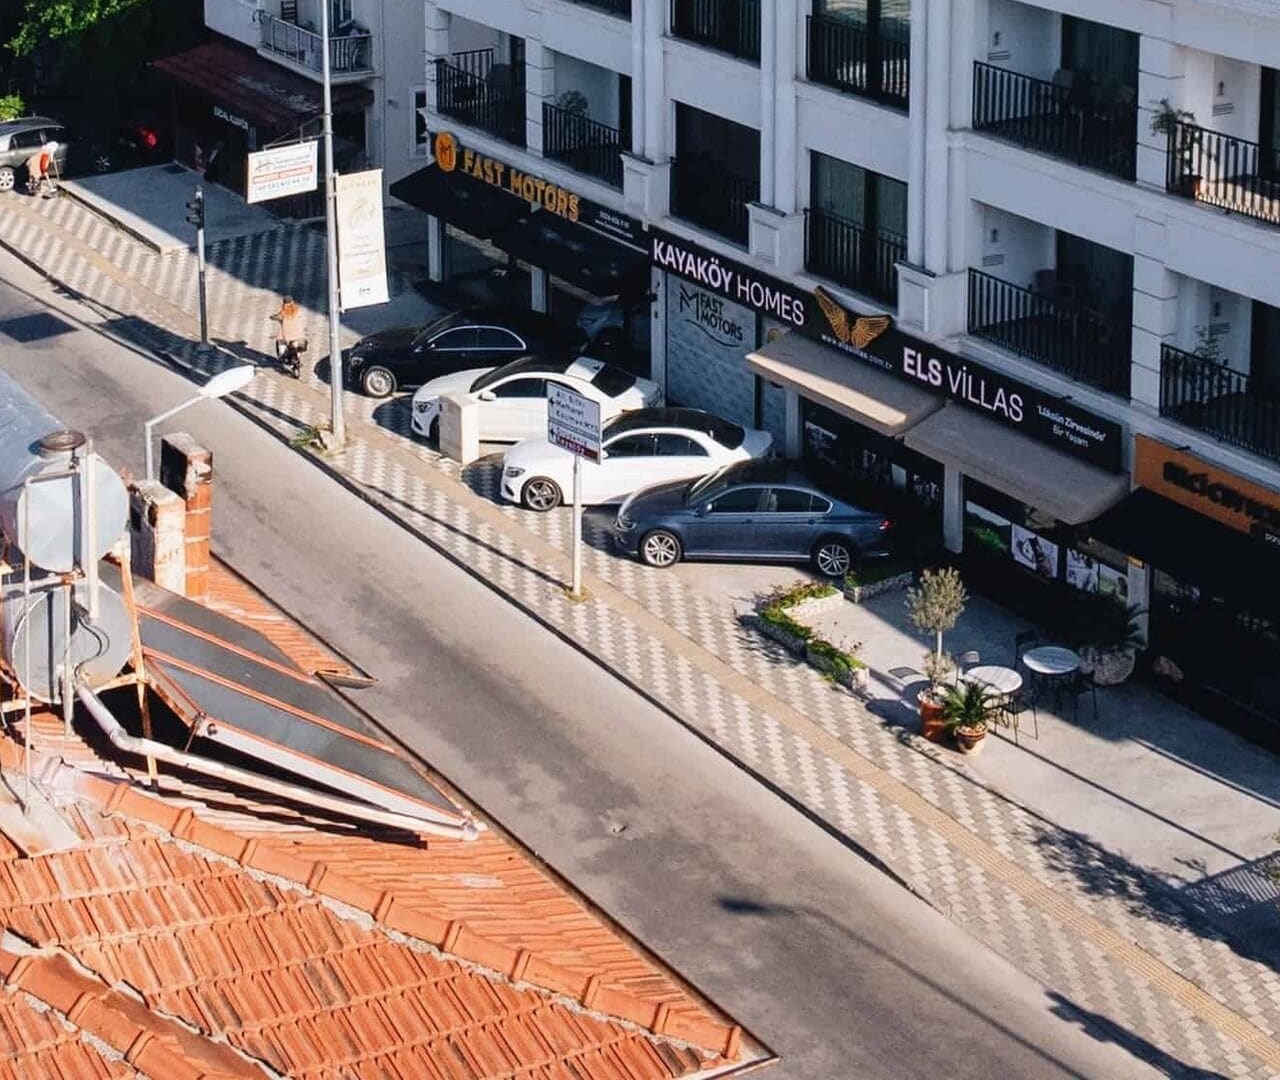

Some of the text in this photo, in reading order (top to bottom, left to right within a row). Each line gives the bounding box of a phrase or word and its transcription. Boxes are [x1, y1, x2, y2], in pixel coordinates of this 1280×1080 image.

[464, 148, 504, 188] FAST
[510, 169, 581, 222] MOTORS
[653, 238, 805, 326] KAYAKÖY HOMES
[701, 293, 725, 315] FAST
[700, 312, 743, 342] MOTORS
[903, 346, 1024, 422] ELS VİLLAS
